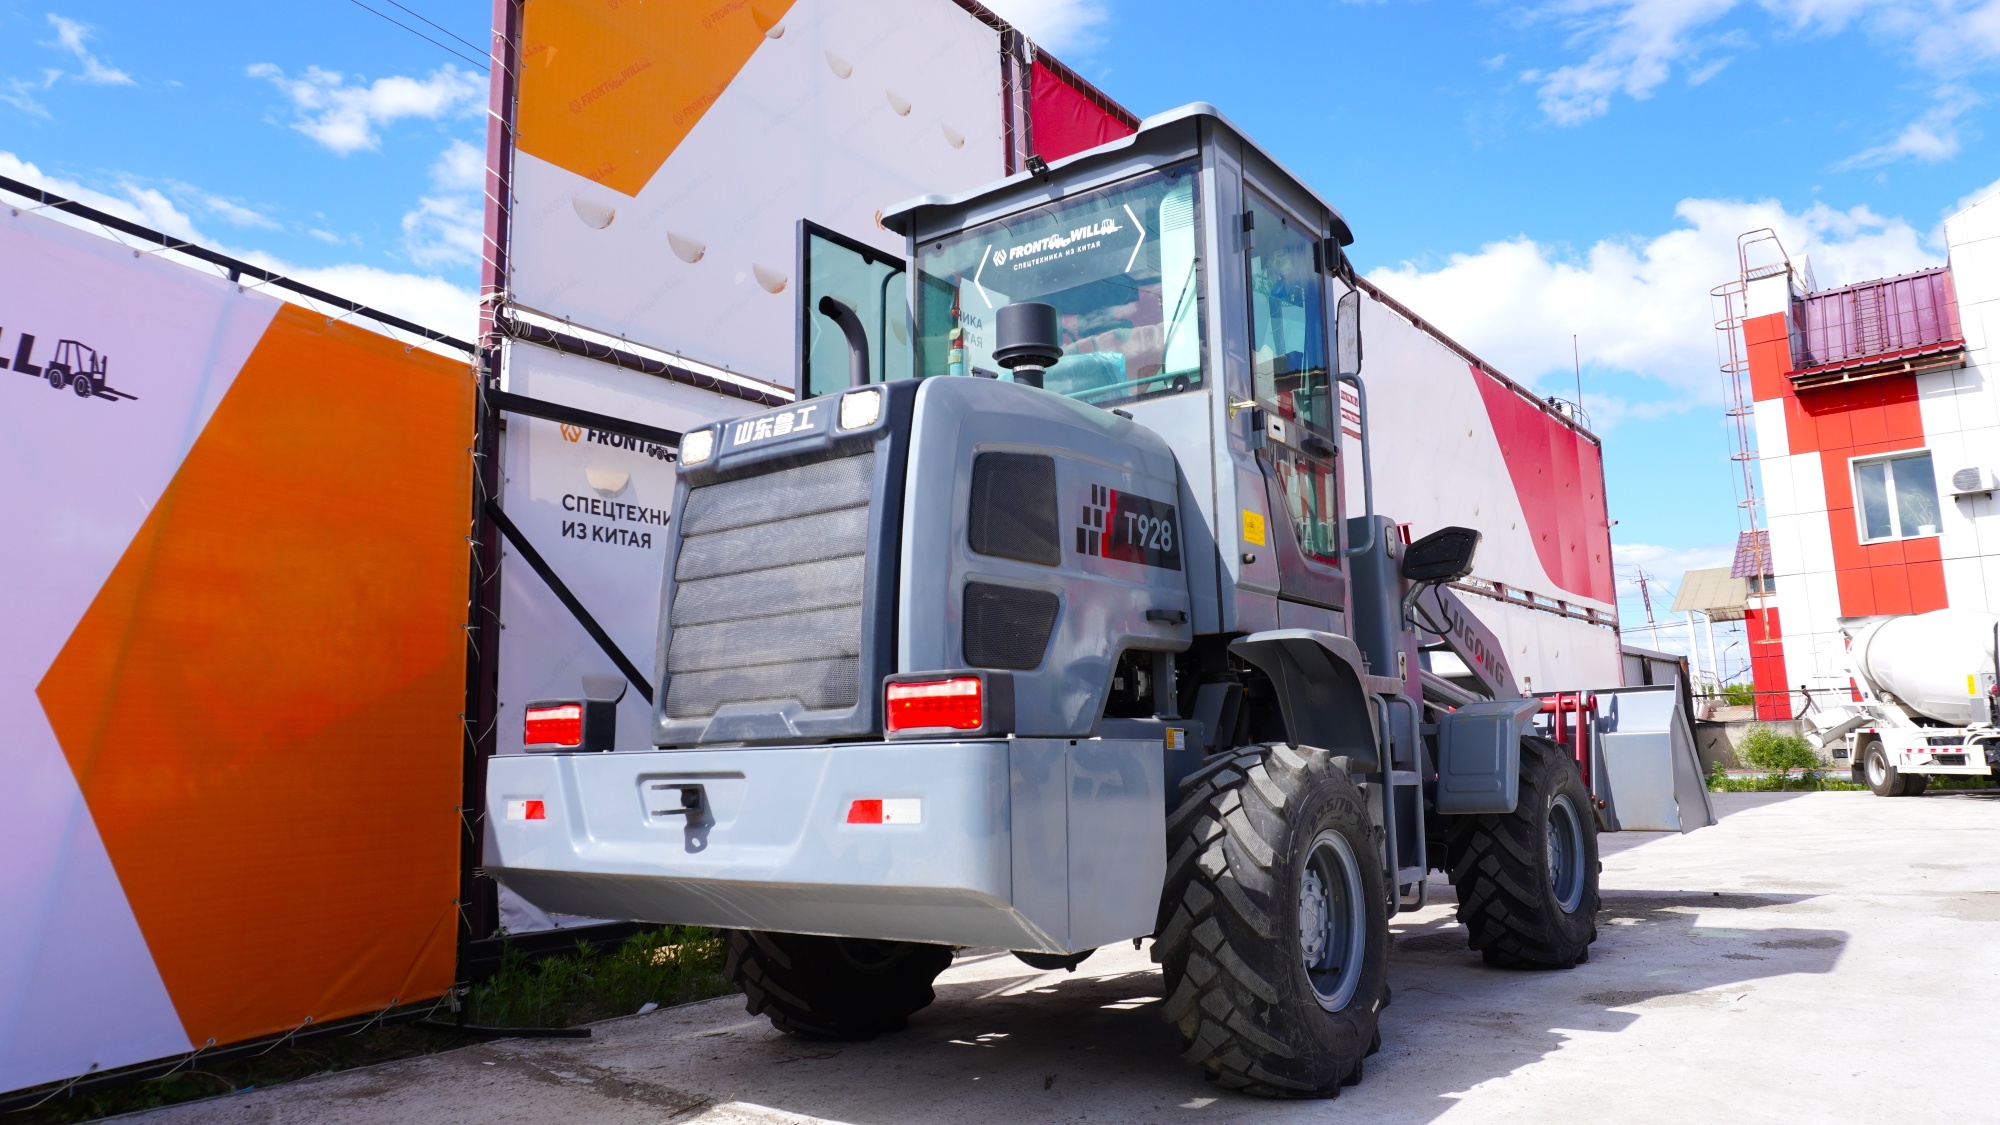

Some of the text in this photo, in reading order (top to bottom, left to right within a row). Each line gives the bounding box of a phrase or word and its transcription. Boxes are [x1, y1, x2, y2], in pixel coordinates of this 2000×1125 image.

[581, 62, 643, 107] FRONT WILL
[1009, 223, 1101, 260] FRONT WILL
[1013, 241, 1101, 271] СПЕЦТЕХНИКА ИЗ КИТАЯ
[734, 405, 817, 446] 山东鲁工
[562, 520, 651, 549] ИЗ КИТАЯ
[1124, 511, 1172, 553] T928
